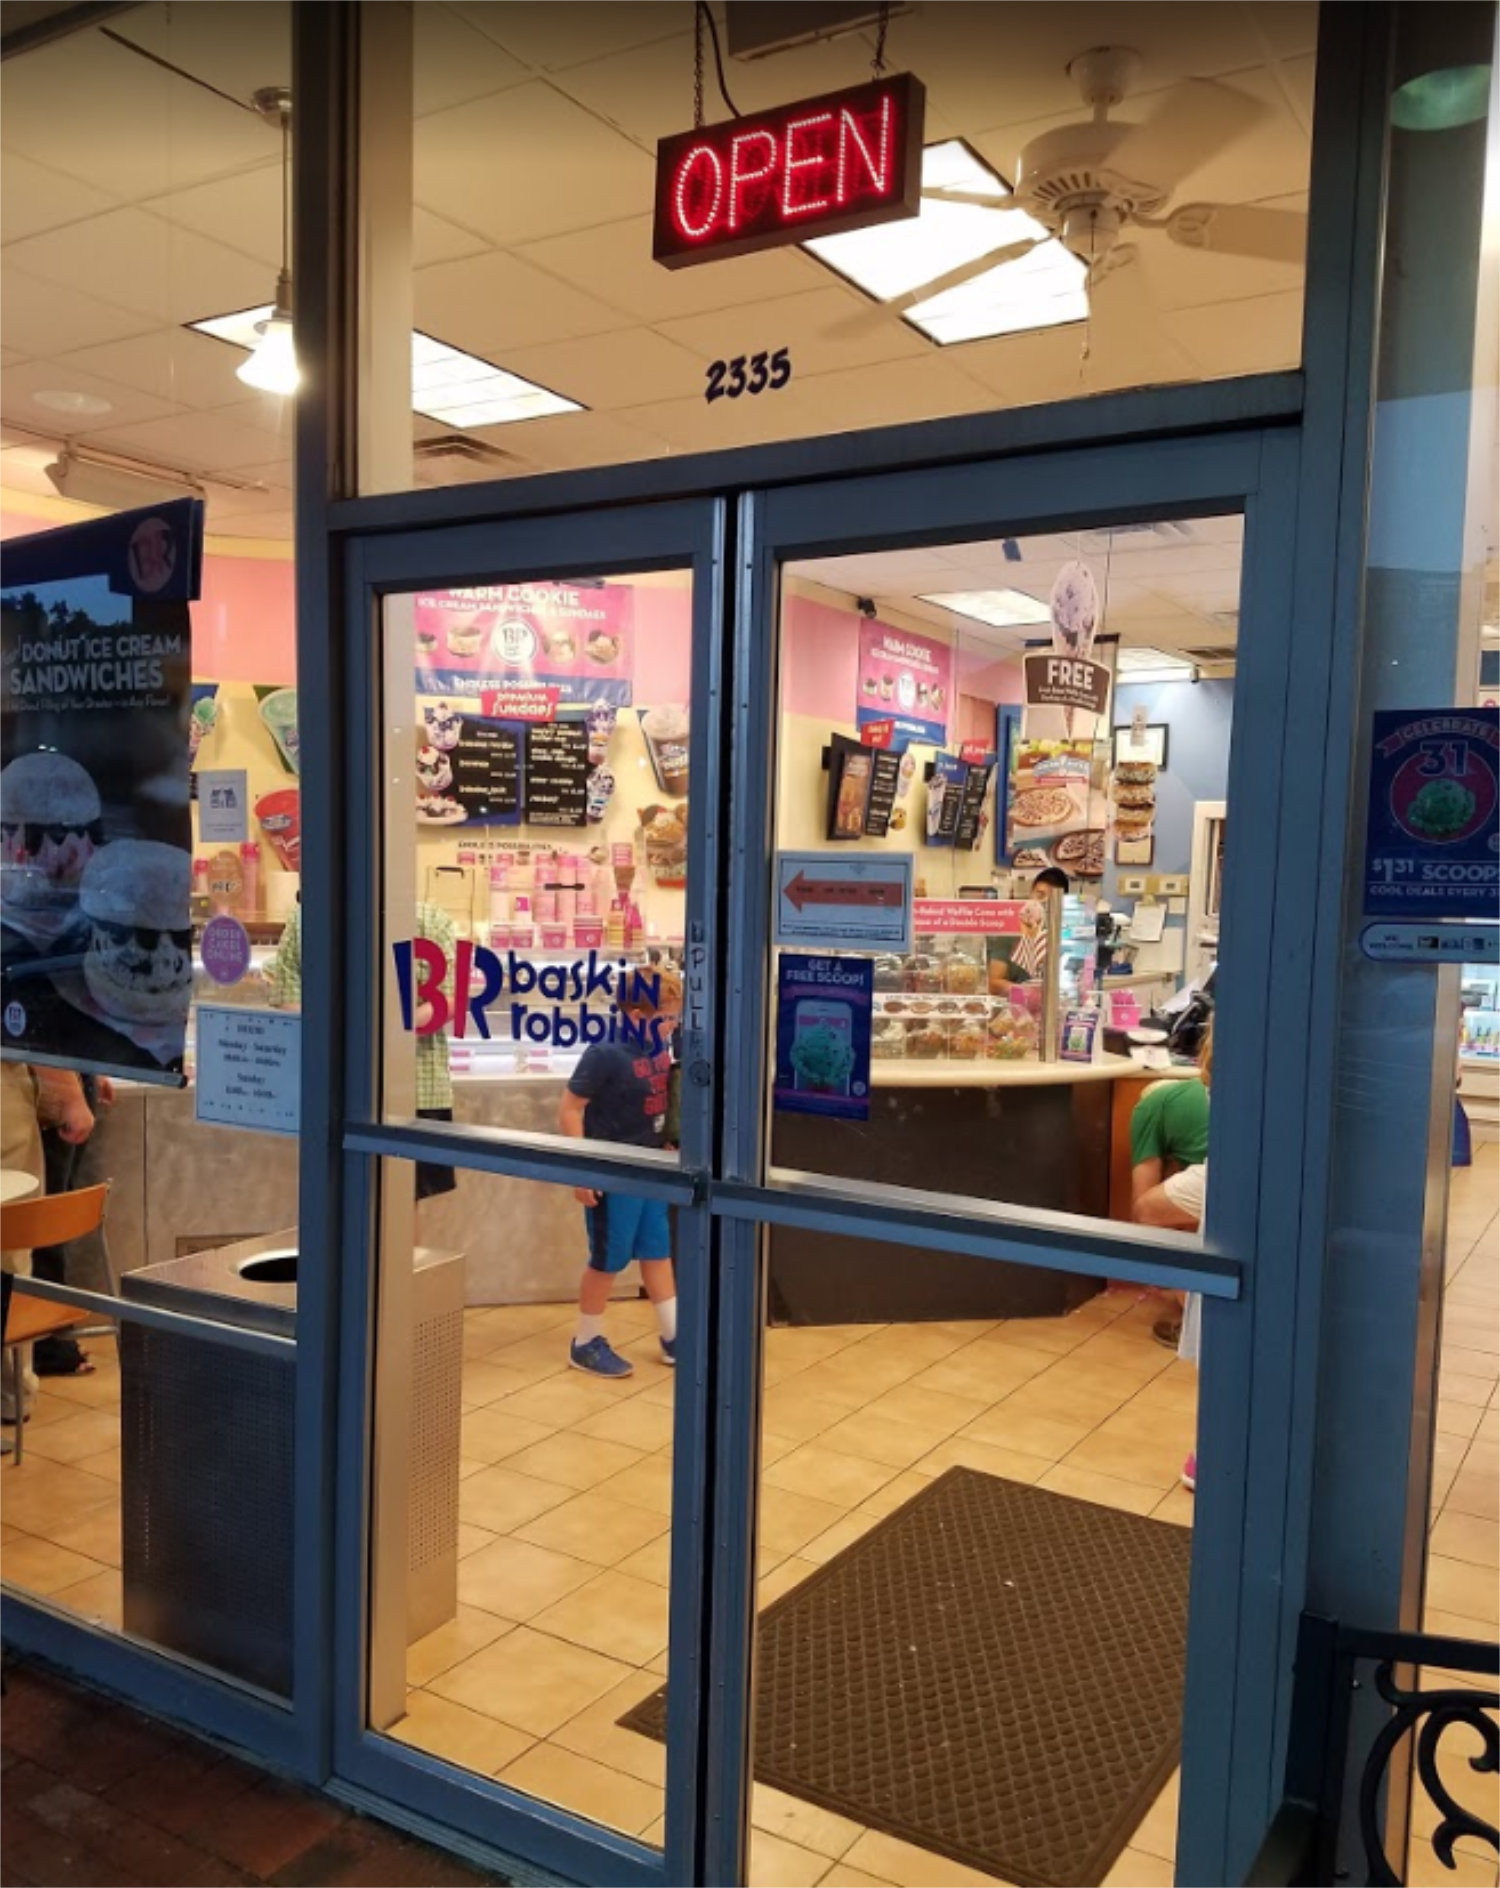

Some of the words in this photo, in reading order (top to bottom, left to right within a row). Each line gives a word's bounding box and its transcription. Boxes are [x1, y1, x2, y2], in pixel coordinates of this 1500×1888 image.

[673, 94, 893, 238] OPEN
[705, 347, 792, 403] 2335
[416, 597, 436, 609] ICE
[449, 586, 504, 602] WARM
[507, 585, 581, 607] COOKIE
[22, 638, 81, 664] DONUT
[85, 637, 113, 660] ICE
[116, 634, 182, 658] CREAM
[10, 659, 164, 696] SANDWICHES
[1047, 659, 1095, 691] FREE
[1402, 717, 1489, 740] CELEBRATE
[1416, 739, 1470, 778] 31
[1422, 864, 1499, 882] SCOOP
[1370, 885, 1404, 897] COOL
[1406, 886, 1445, 897] DEALS
[1447, 887, 1486, 898] EVERY
[785, 969, 815, 982] FREE
[816, 971, 865, 987] SCOOP!
[807, 958, 832, 971] GET
[833, 960, 844, 972] A
[393, 937, 504, 1040] BR
[508, 949, 661, 1010] baskin
[511, 1002, 666, 1058] robbins
